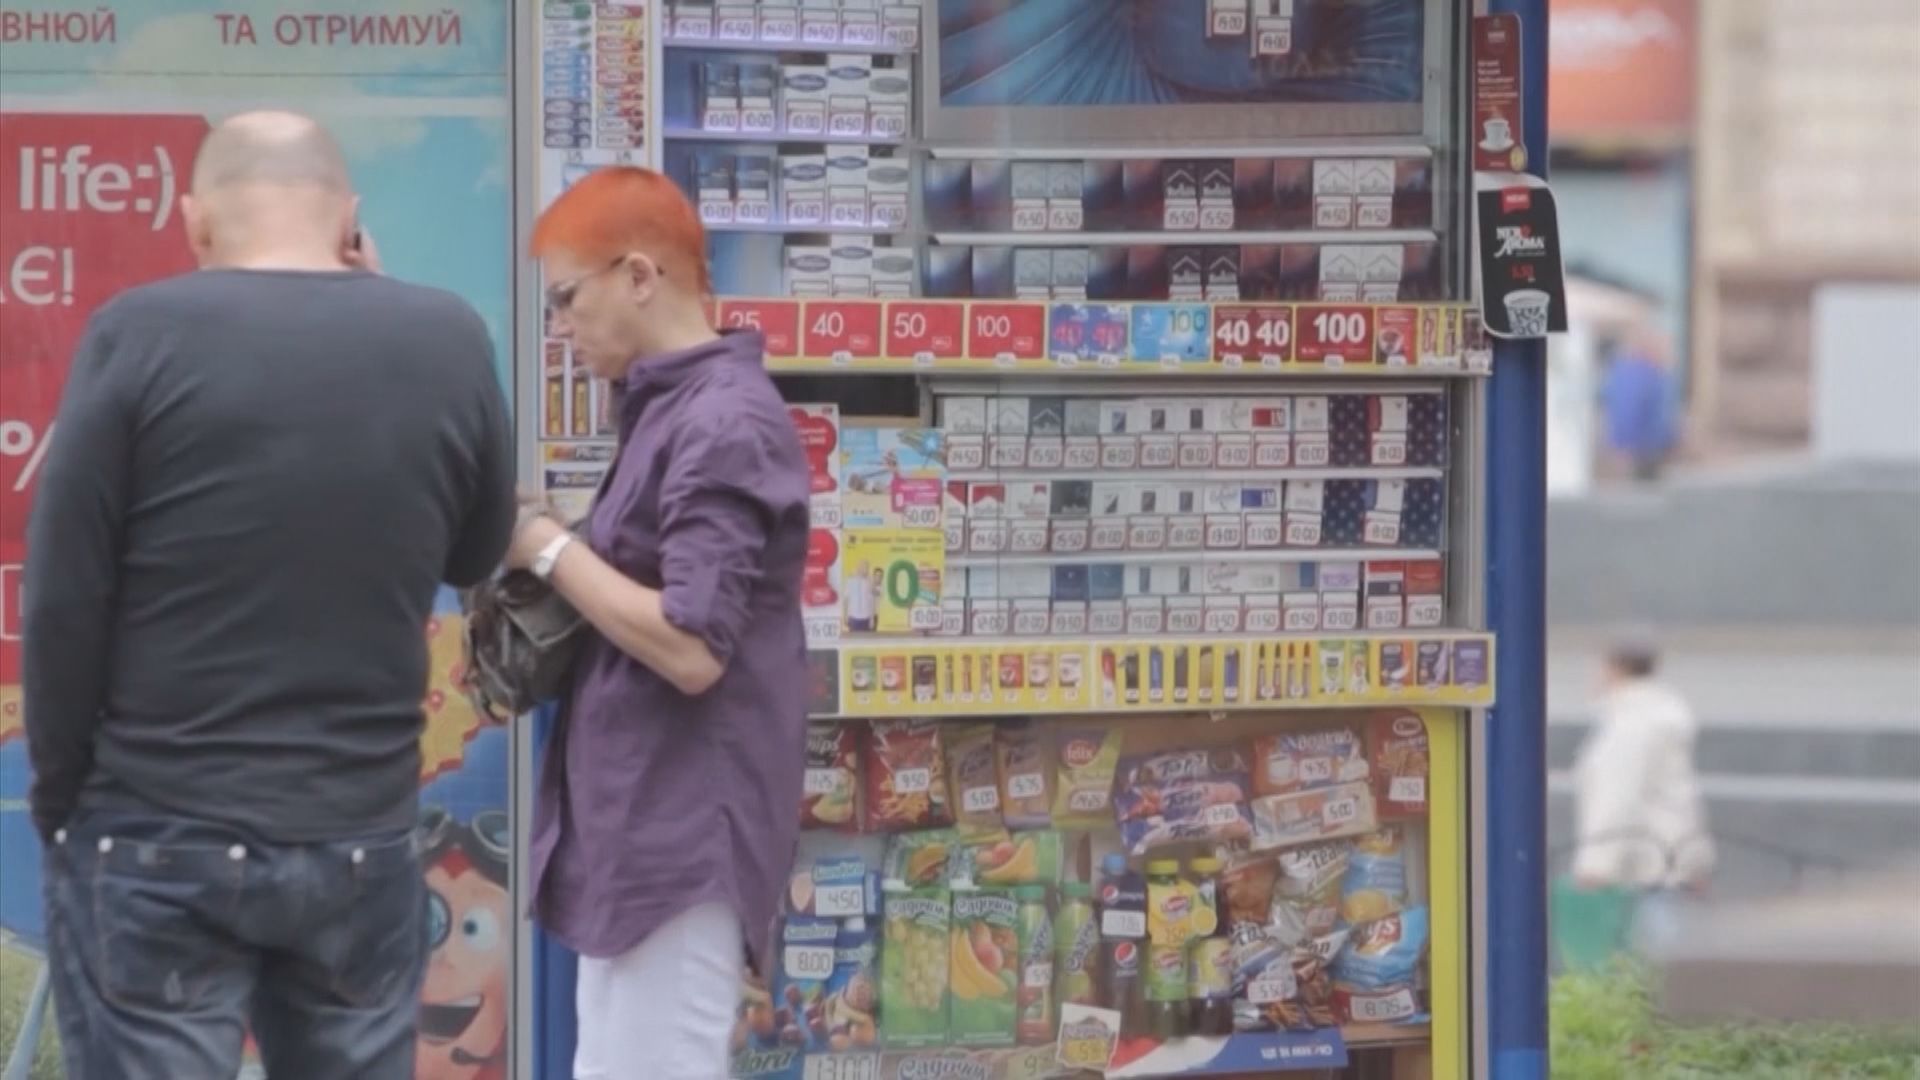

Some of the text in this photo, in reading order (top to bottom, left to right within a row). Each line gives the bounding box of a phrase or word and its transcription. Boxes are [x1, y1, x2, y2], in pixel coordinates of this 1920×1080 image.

[2, 9, 117, 43] ВНЮЙ
[215, 9, 461, 46] ТА ОТРИМУЙ
[19, 145, 176, 230] life:)
[0, 247, 75, 305] Є!
[812, 312, 843, 337] 40
[894, 313, 926, 338] 50
[976, 315, 1010, 338] 100
[1170, 309, 1207, 332] 100
[1216, 319, 1290, 347] 40 40
[1313, 312, 1366, 343] 100
[887, 560, 918, 608] 0
